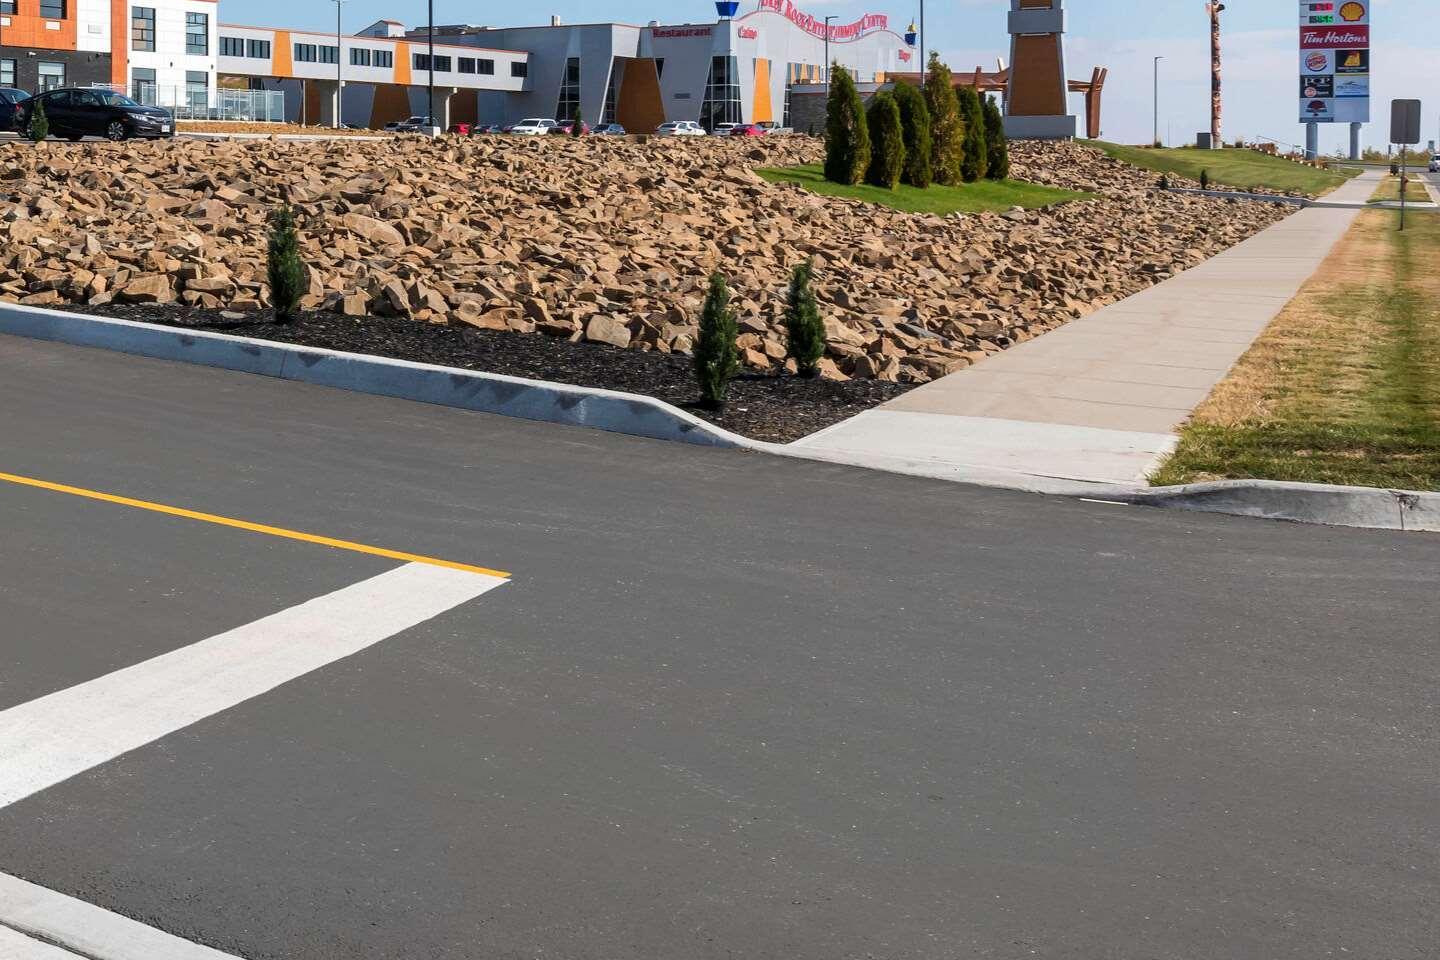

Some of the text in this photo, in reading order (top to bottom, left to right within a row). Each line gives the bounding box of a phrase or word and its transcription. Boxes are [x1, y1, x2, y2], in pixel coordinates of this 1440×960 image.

[784, 0, 808, 28] ROCK
[652, 26, 712, 38] Restaurant
[1303, 31, 1368, 43] Tim Hortons
